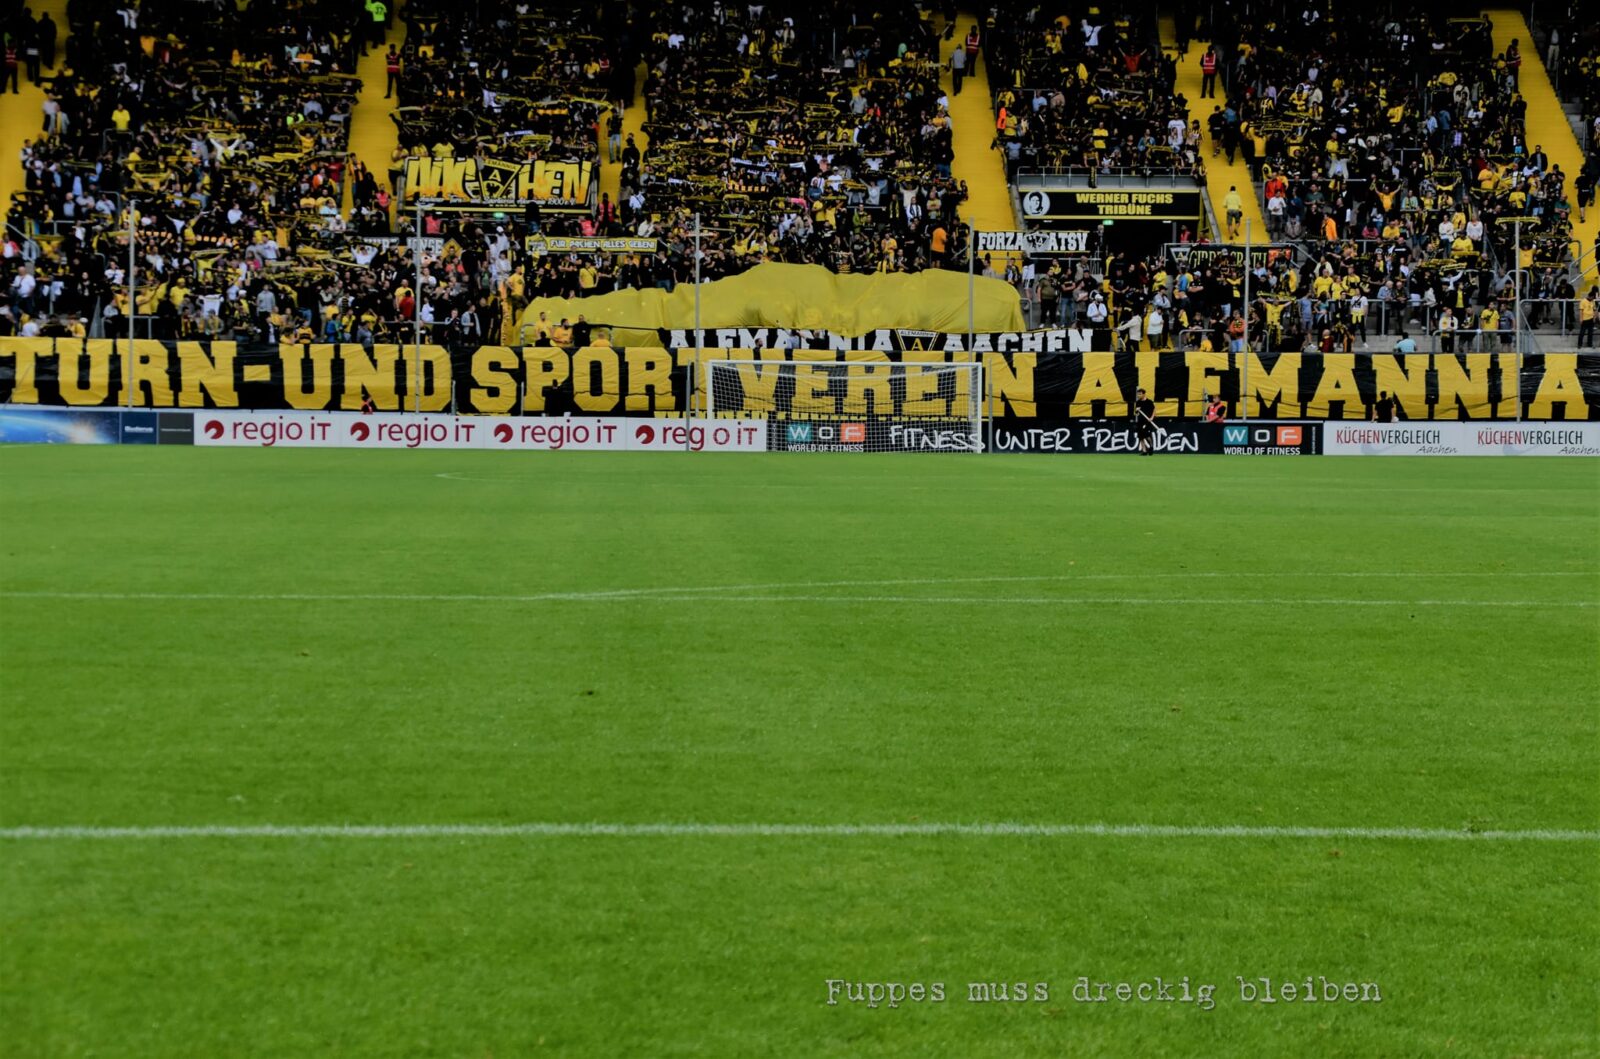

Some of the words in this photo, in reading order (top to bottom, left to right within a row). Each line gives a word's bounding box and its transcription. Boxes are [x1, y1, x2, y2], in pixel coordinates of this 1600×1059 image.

[1076, 193, 1128, 204] WERNER
[1132, 193, 1174, 204] FUCHS
[1097, 203, 1152, 215] TRIBÜNE
[978, 231, 1024, 251] FORZA
[1048, 231, 1088, 251] ATSV
[944, 329, 1094, 352] AACHEN
[1069, 352, 1589, 420] ALEMANNIA
[233, 416, 303, 446] regio
[377, 417, 447, 448] regio
[521, 418, 592, 449] regio
[662, 425, 729, 451] rego
[889, 424, 986, 450] FITNESS
[995, 427, 1072, 450] UNTER
[1336, 429, 1440, 445] KÜCHENVERGLEICH
[1477, 429, 1583, 445] KÜCHENVERGLEICH
[787, 444, 816, 452] WORLD
[819, 444, 828, 452] OF
[831, 444, 864, 452] FITNESS
[1223, 446, 1252, 456] WORLD
[1254, 446, 1265, 456] OF
[1267, 446, 1301, 456] FITNESS
[1416, 445, 1458, 455] Aachen
[1558, 445, 1600, 455] Aachen
